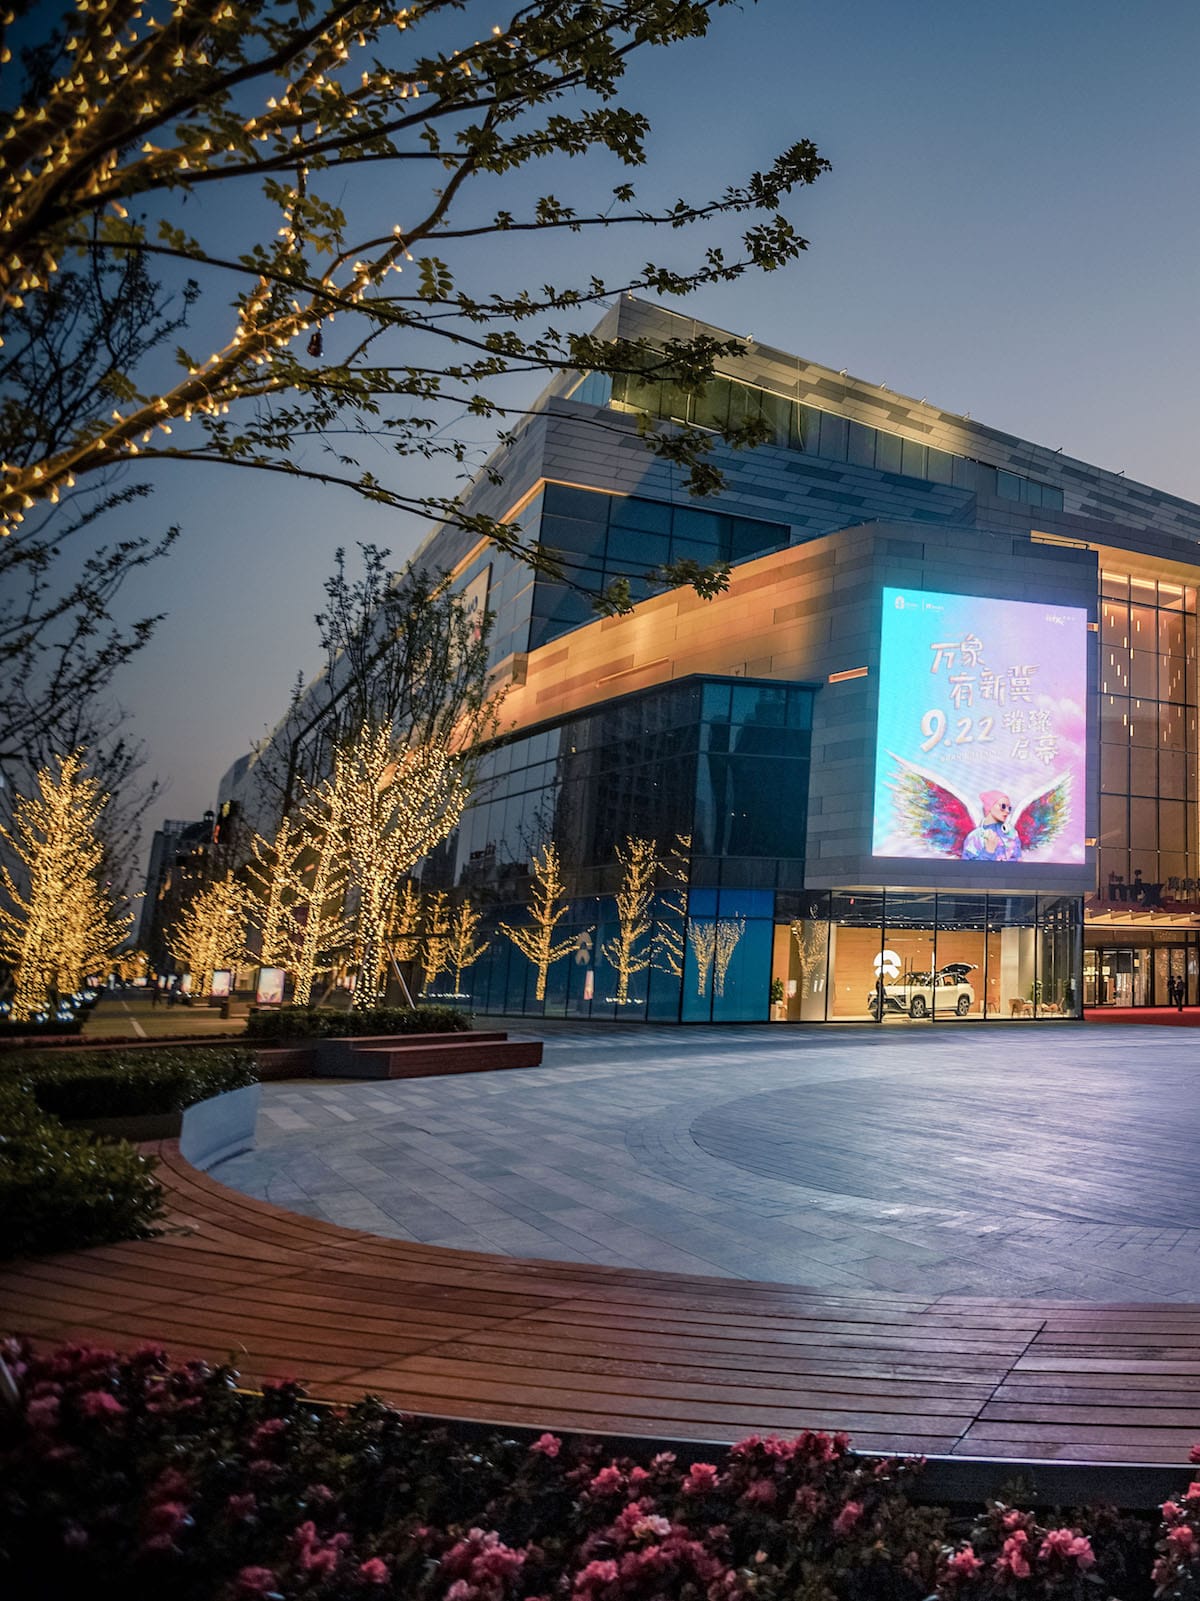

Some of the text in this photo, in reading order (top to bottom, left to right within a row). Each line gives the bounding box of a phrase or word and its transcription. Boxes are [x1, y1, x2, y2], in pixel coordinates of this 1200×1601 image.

[929, 632, 985, 673] 万象
[920, 708, 995, 752] 9.22
[1009, 734, 1059, 765] 启幕
